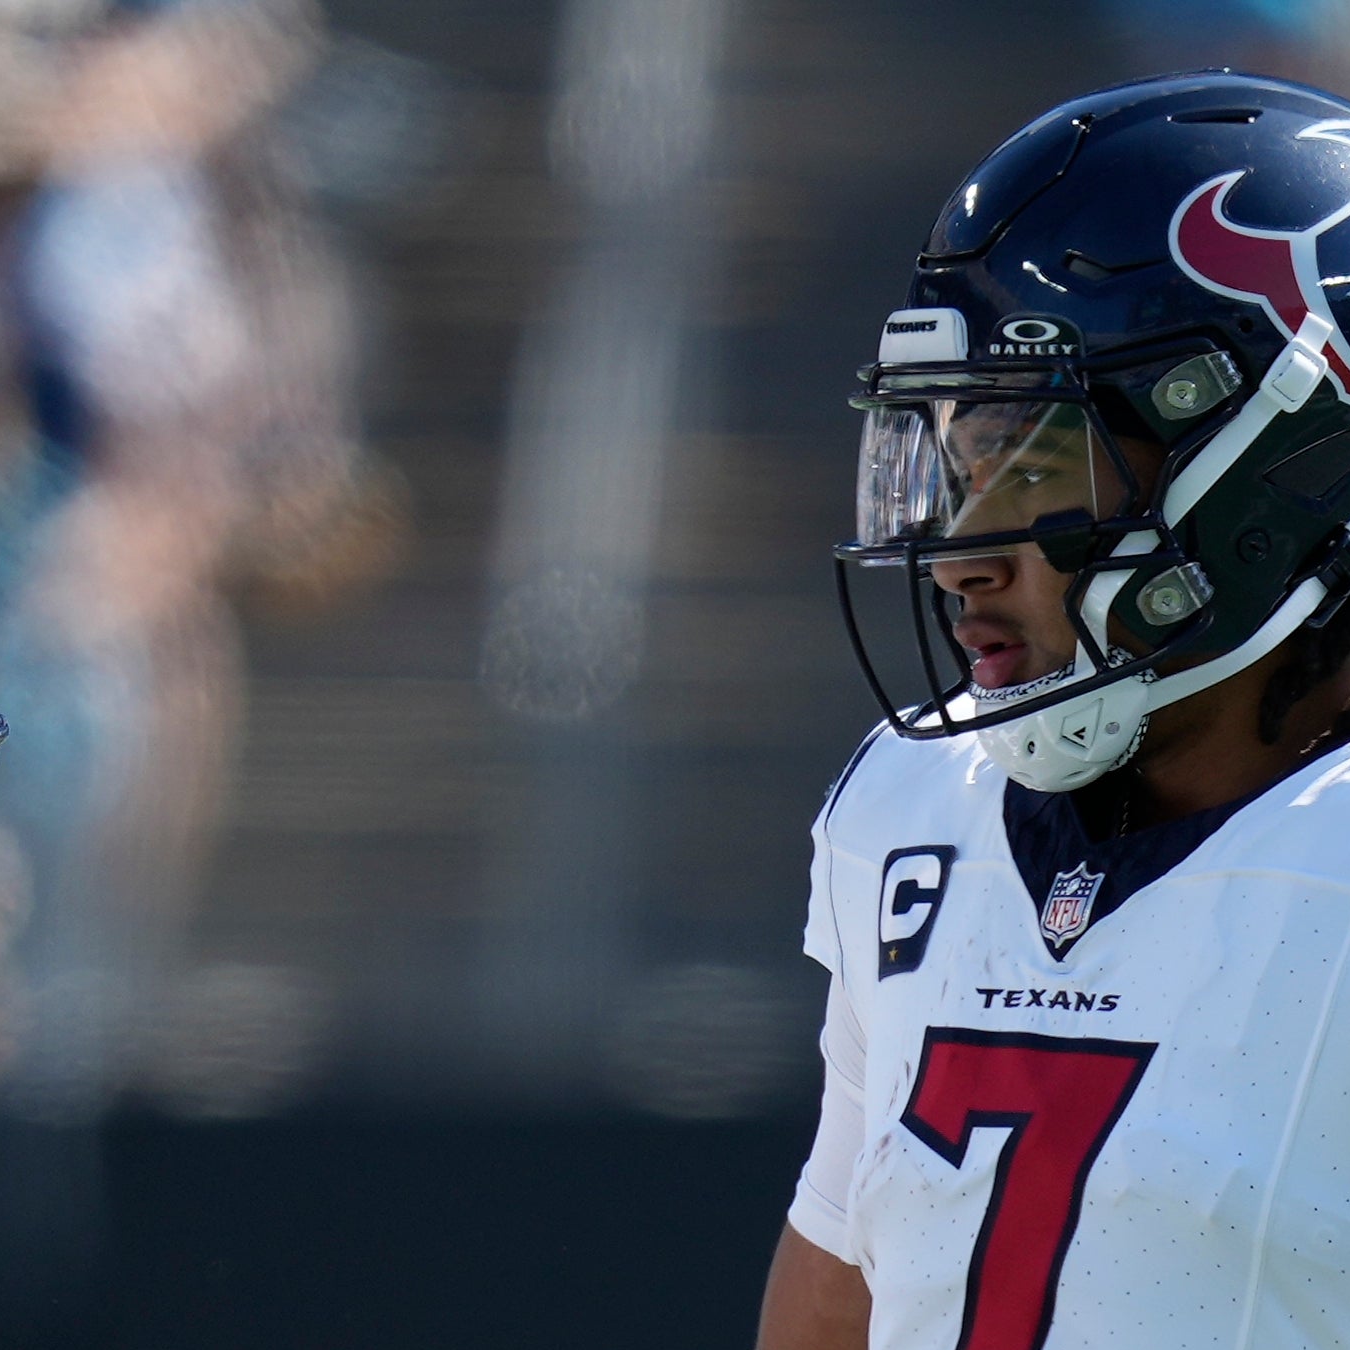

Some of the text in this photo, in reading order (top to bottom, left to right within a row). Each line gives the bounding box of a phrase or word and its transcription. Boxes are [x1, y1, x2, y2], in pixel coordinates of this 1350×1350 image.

[989, 343, 1076, 356] OAKLEY
[881, 853, 942, 943] C
[1046, 899, 1083, 929] NFL
[975, 987, 1122, 1013] TEXANS
